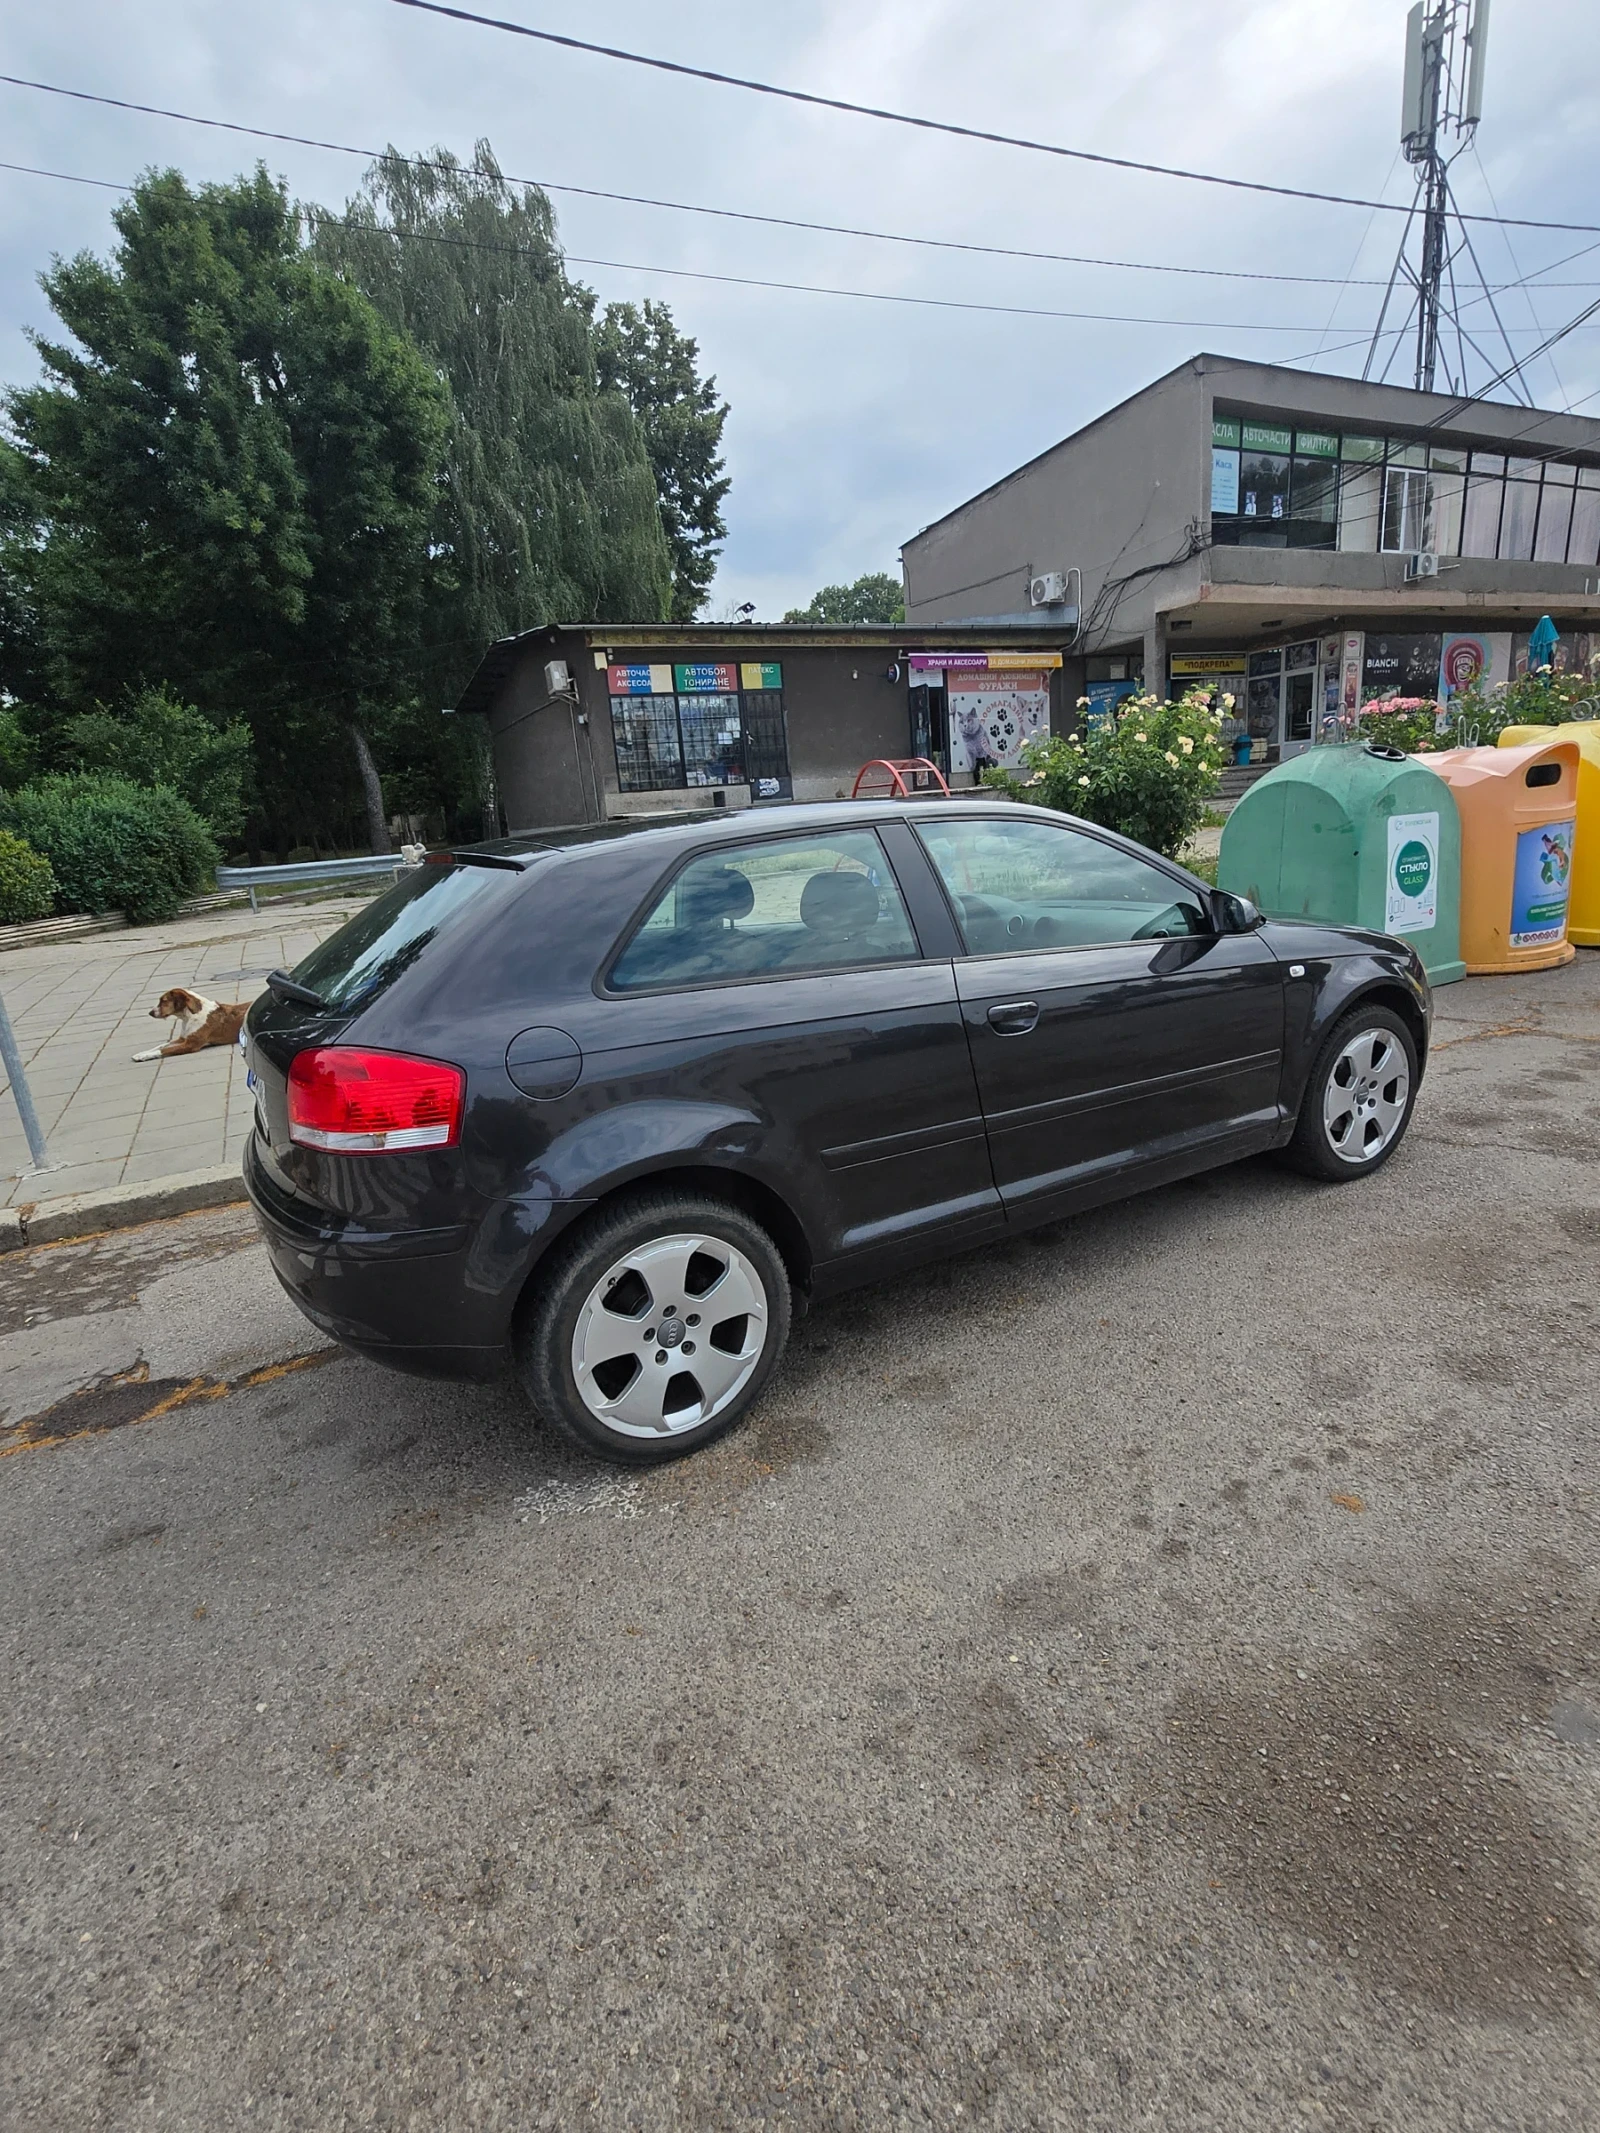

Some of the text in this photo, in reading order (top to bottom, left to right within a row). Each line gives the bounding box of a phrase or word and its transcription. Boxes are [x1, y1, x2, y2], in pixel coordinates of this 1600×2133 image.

[1242, 427, 1292, 446] АВТОЧАСТИ
[1300, 435, 1335, 452] ФИЛТРИ
[927, 658, 947, 666] ХРАНИ
[953, 658, 987, 666] АКСЕСОАРИ
[1366, 658, 1399, 669] BIANCHI
[684, 667, 727, 676] АВТОБОЯ
[683, 677, 730, 687] ТОНИРАНЕ
[978, 682, 1018, 691] ФУРАЖИ
[1399, 861, 1429, 874] СТЪКЛО
[1403, 875, 1424, 885] GLASS
